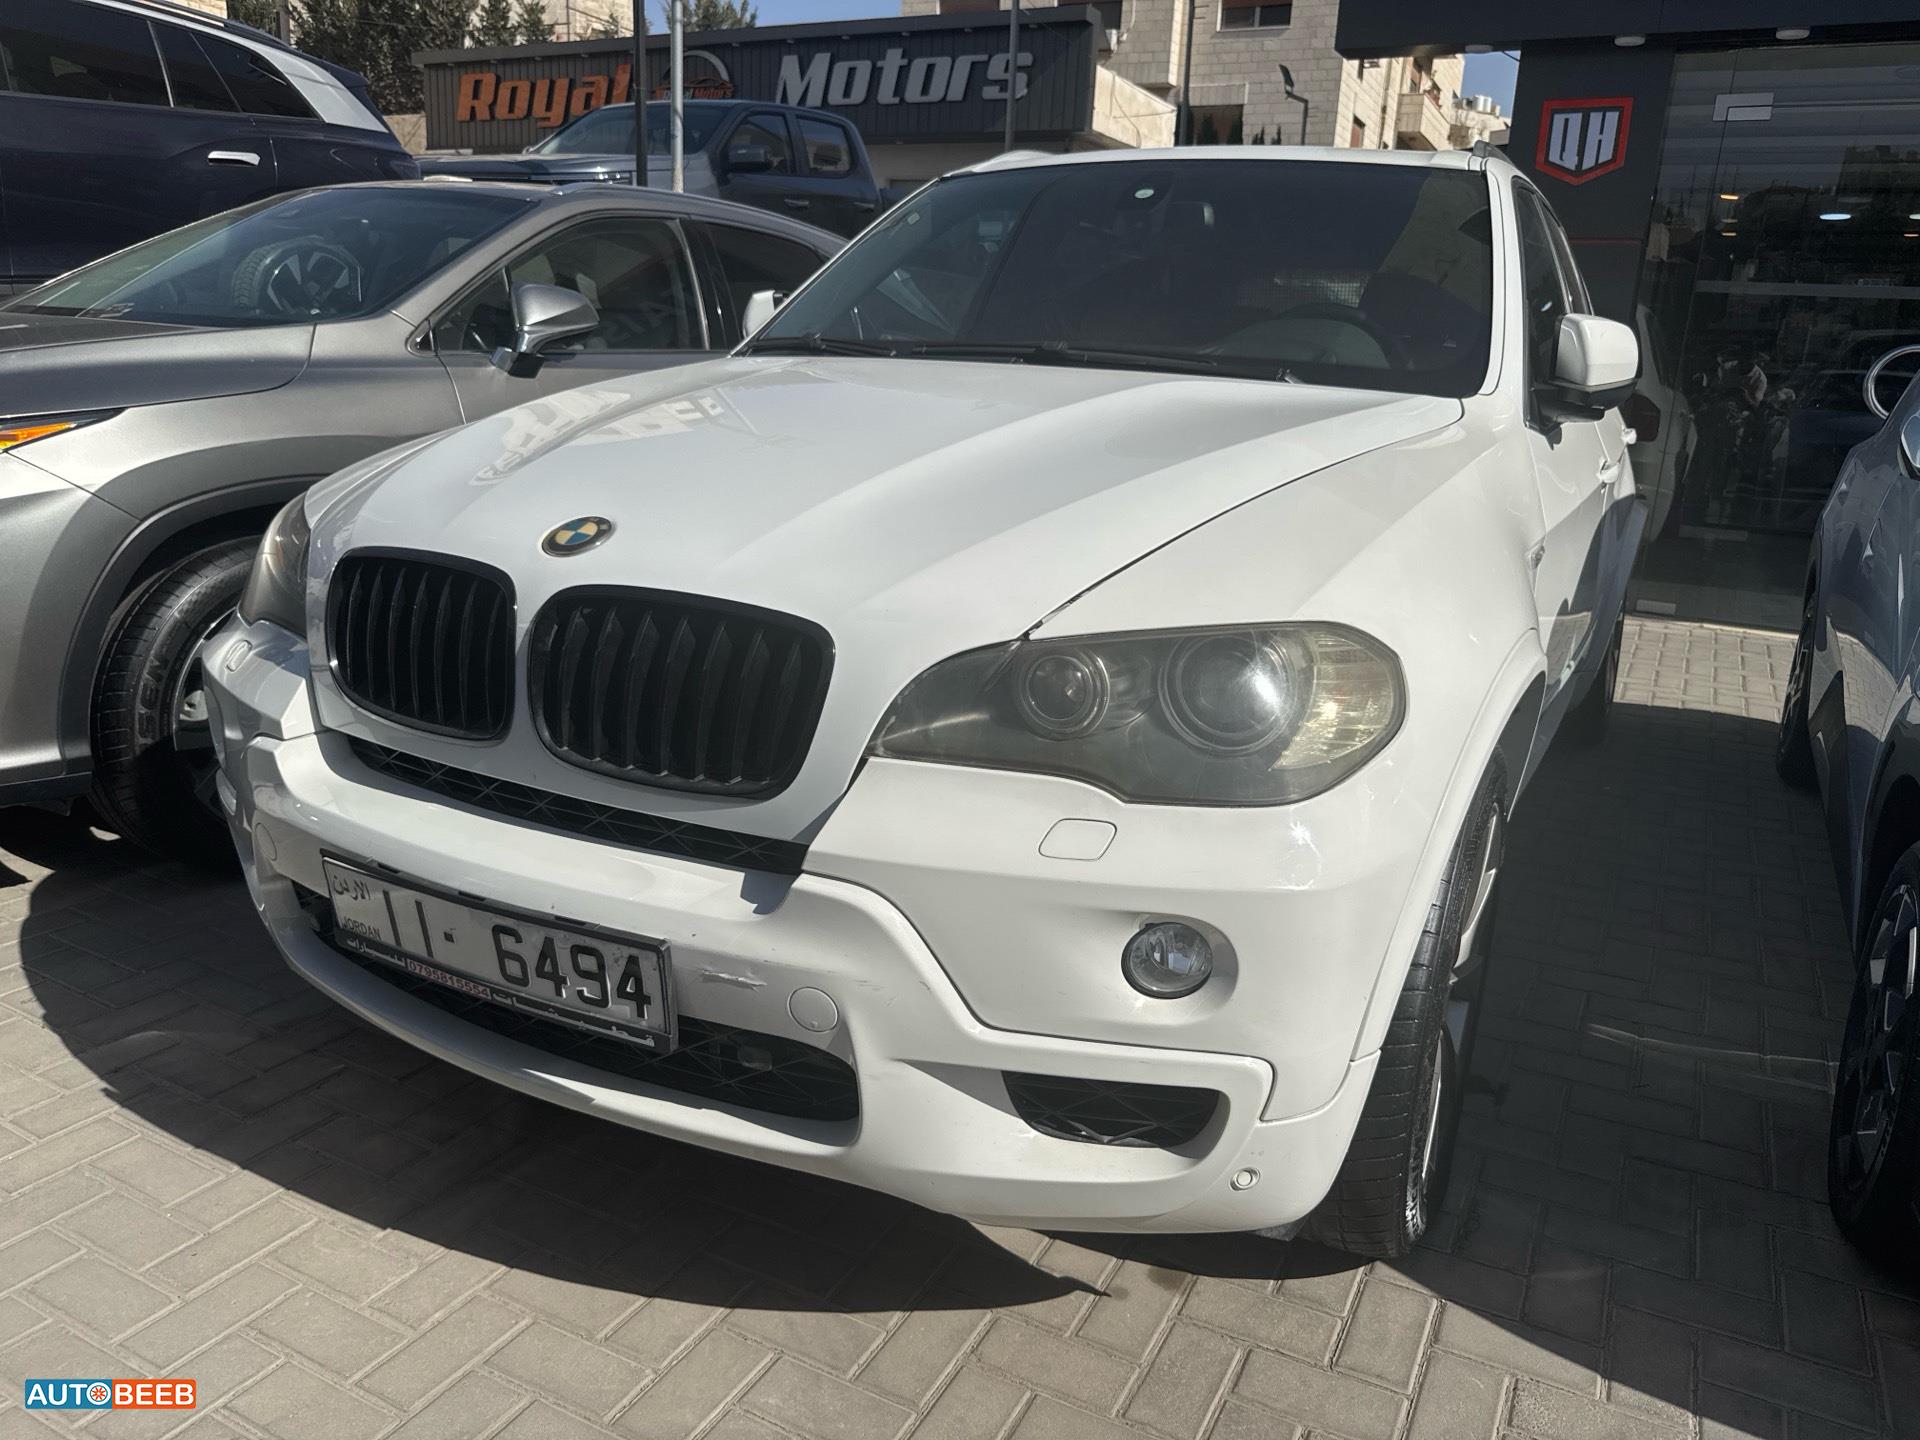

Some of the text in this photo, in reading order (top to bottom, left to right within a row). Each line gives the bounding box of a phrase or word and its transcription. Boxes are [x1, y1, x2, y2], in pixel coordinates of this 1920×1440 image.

[457, 48, 1033, 128] Royal Motors
[1548, 111, 1620, 171] QH
[343, 916, 382, 941] JORDAN
